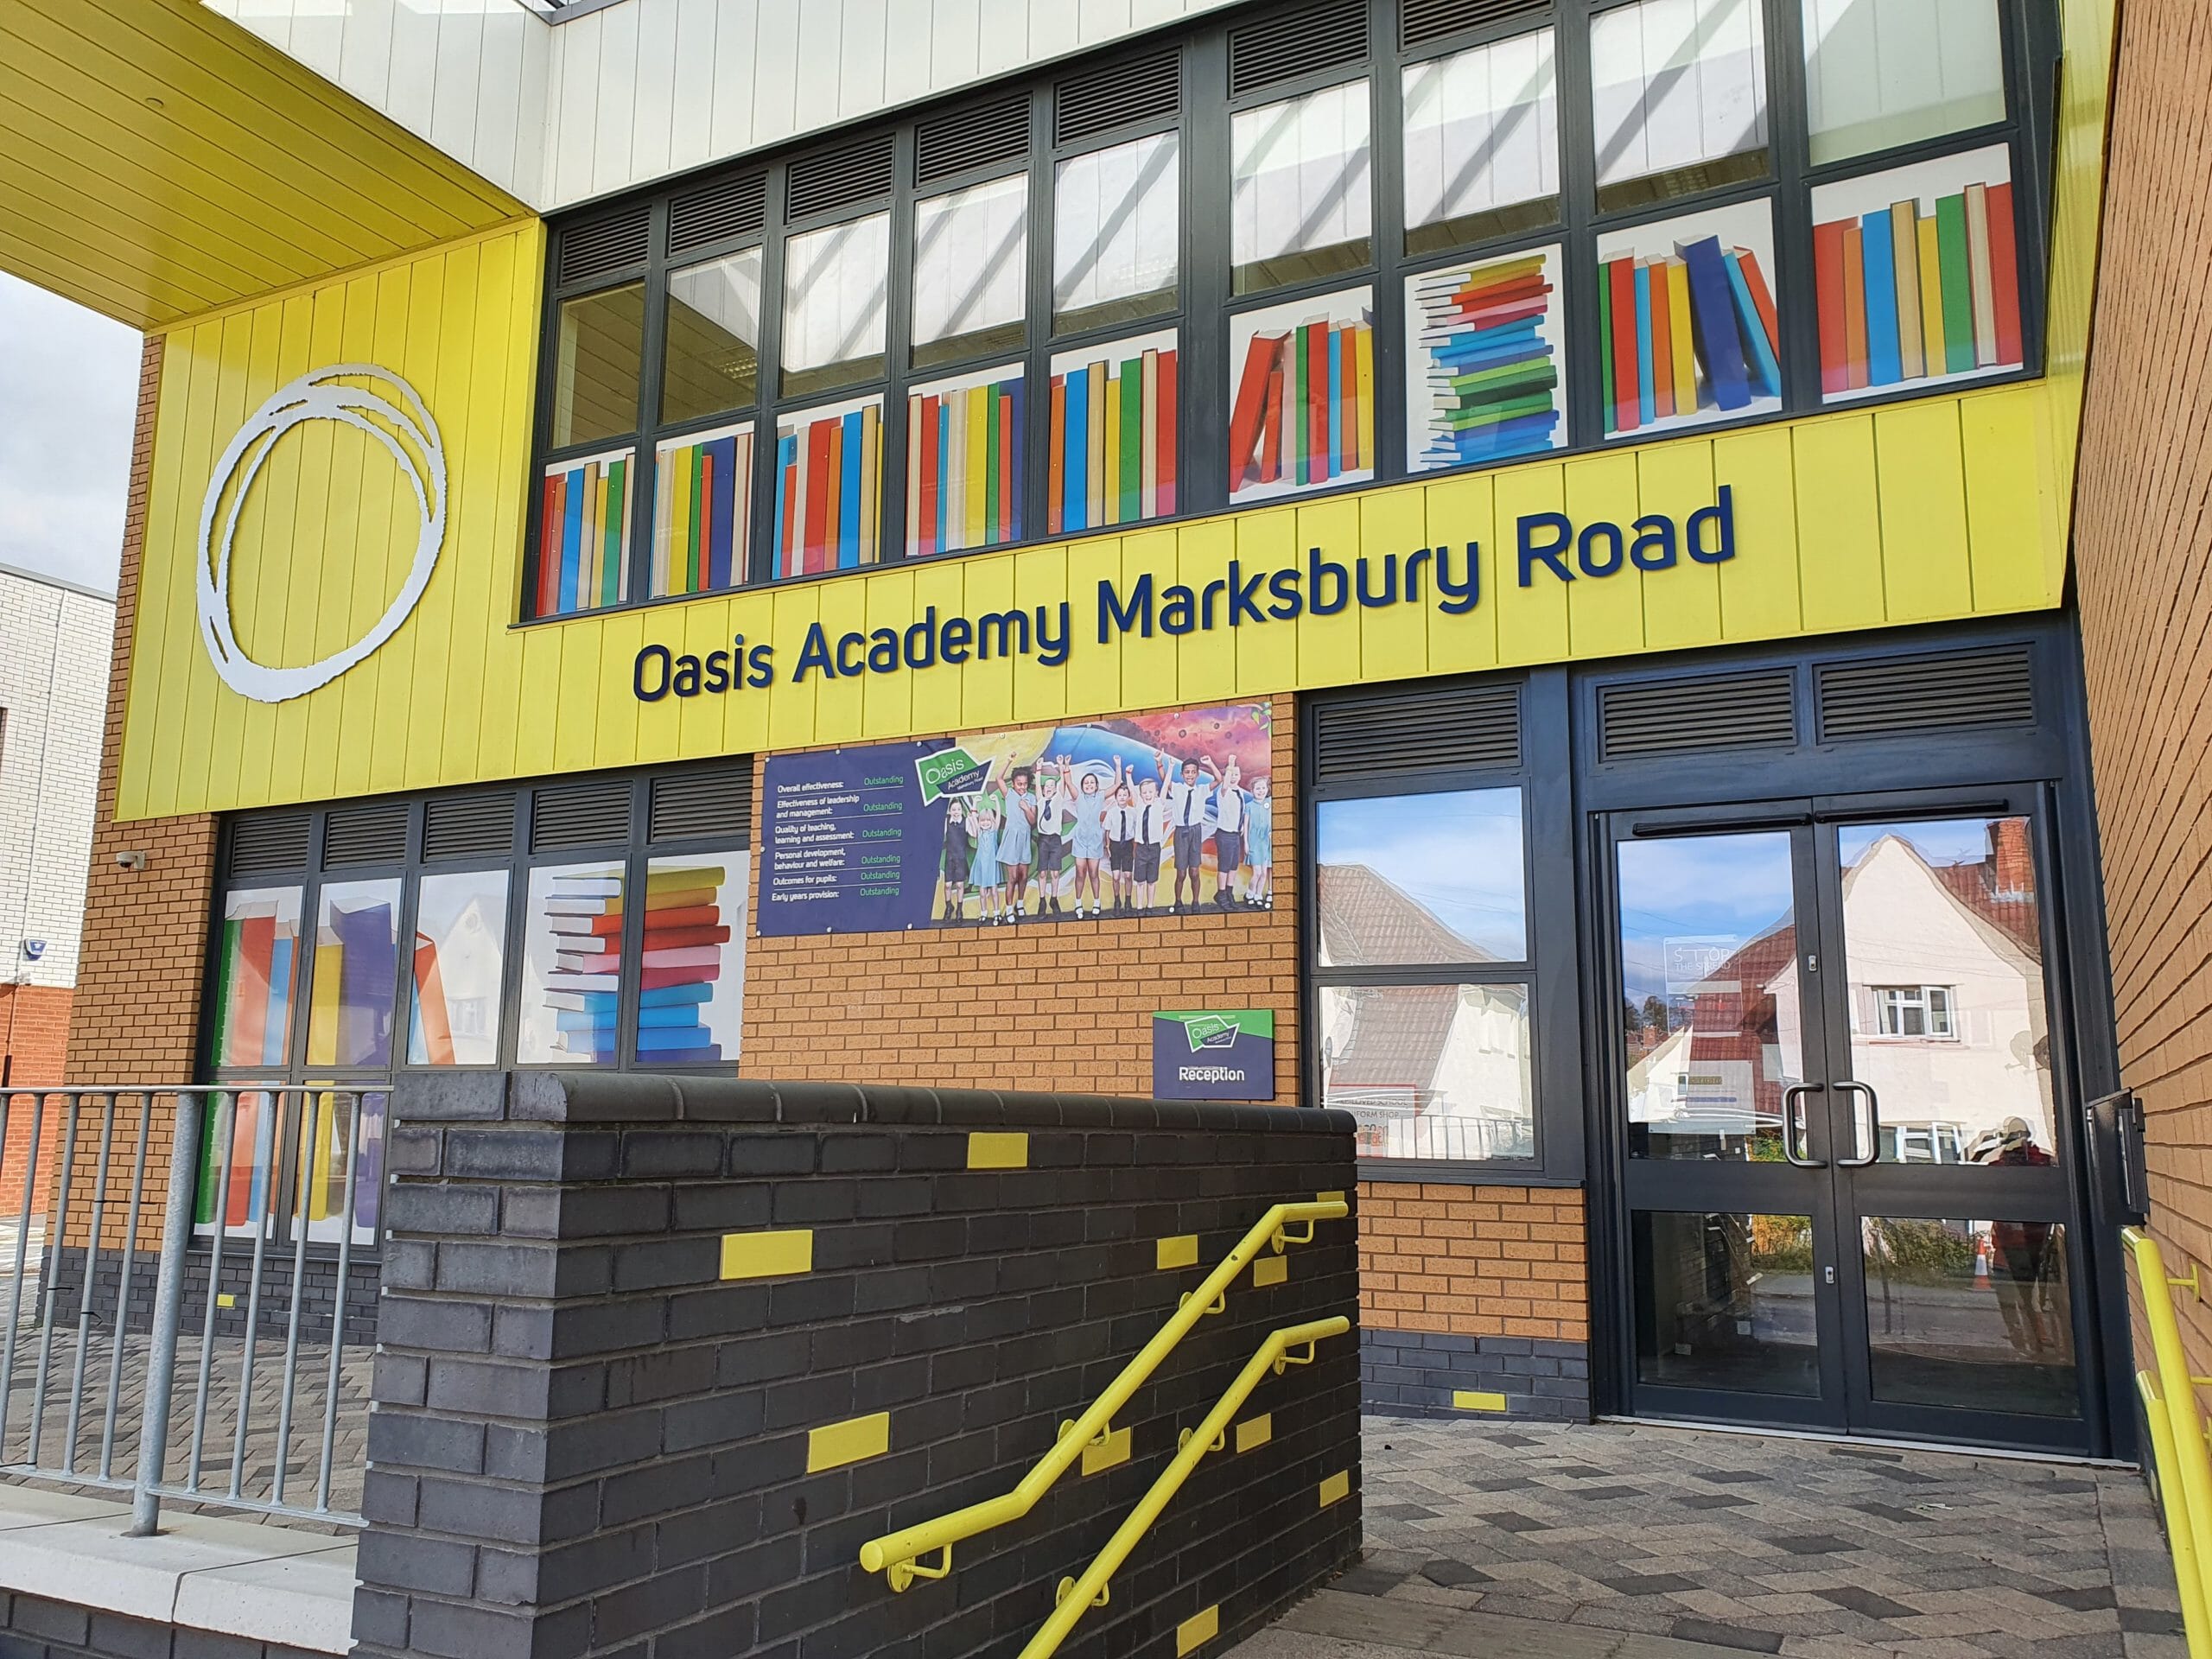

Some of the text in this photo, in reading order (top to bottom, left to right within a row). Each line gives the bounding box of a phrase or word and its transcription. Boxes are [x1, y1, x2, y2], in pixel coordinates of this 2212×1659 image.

[633, 484, 1736, 702] Oasis Academy Marksbury Road
[925, 759, 964, 784] Oasis
[864, 776, 903, 785] Outstanding
[948, 770, 980, 790] Academy
[778, 781, 843, 793] Overall effectiveness:
[777, 794, 860, 808] Effectiveness of leadership
[863, 802, 902, 811] Outstanding
[776, 807, 833, 818] and management:
[774, 825, 798, 835] Quality
[799, 823, 807, 832] of
[861, 828, 901, 838] Outstanding
[774, 836, 801, 844] learning
[815, 831, 855, 842] assessment:
[774, 850, 803, 860] Personal
[861, 855, 900, 864] Outstanding
[774, 861, 804, 870] behaviour
[818, 858, 845, 867] welfare:
[772, 877, 804, 886] Outcomes
[816, 874, 837, 885] pupils:
[861, 871, 899, 880] Outstanding
[772, 890, 840, 902] Early years provision:
[860, 887, 899, 896] Outstanding
[1675, 962, 1694, 971] THE
[1192, 1022, 1220, 1039] Oasis
[1179, 1065, 1246, 1084] Reception
[1379, 1110, 1399, 1119] SHOP
